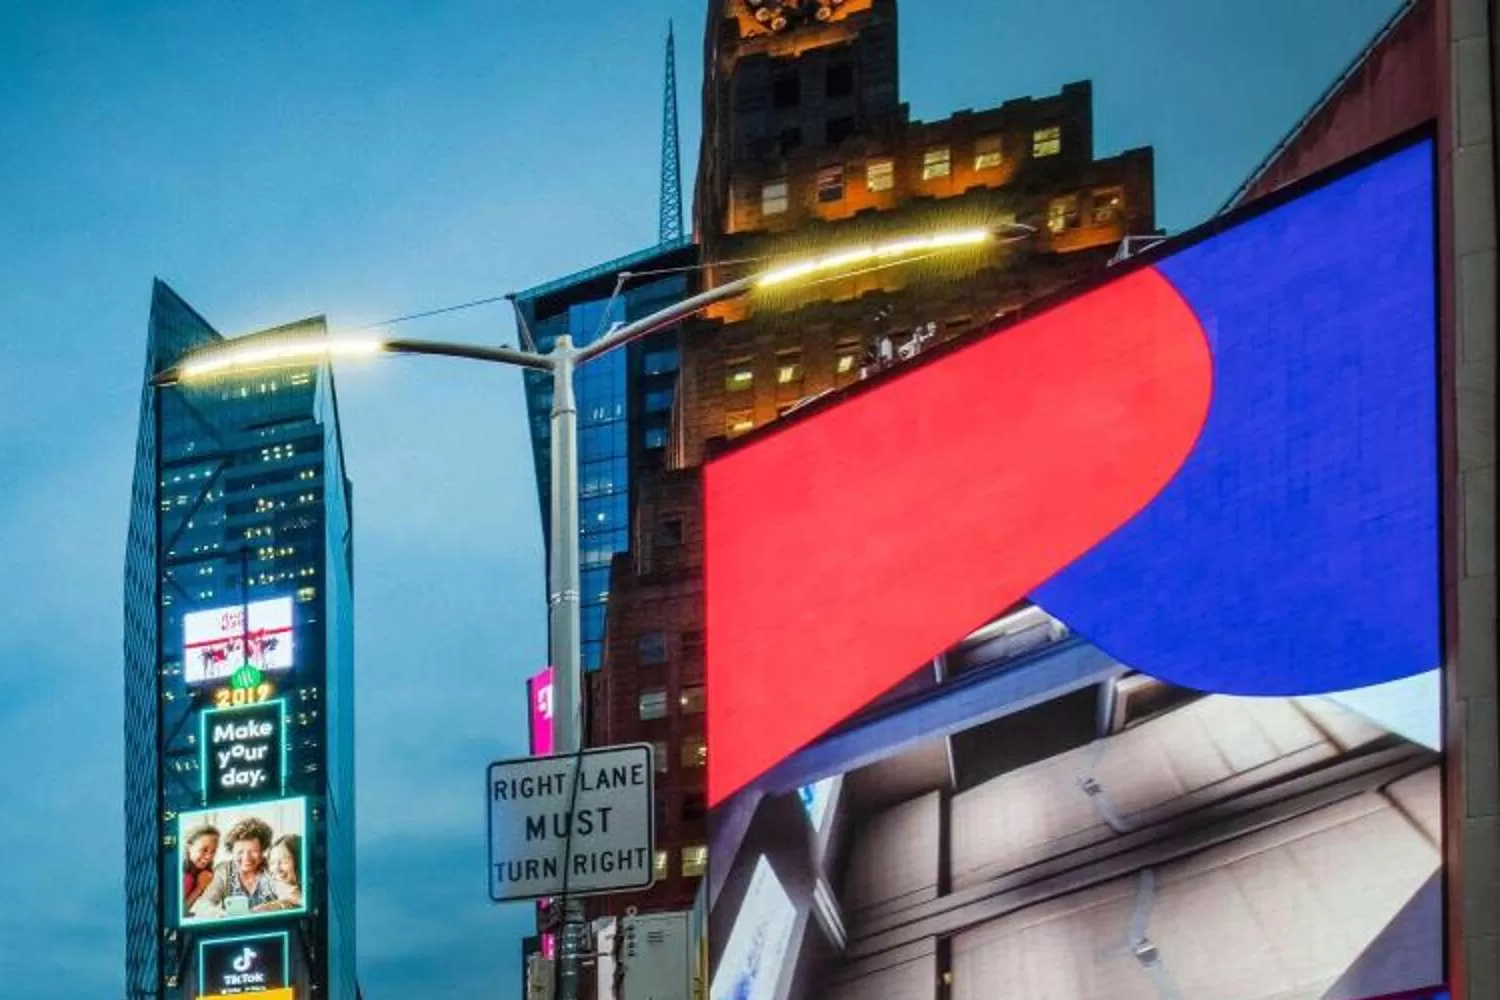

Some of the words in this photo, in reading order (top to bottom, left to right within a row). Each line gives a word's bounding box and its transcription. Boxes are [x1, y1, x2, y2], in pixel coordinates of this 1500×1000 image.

[213, 719, 273, 743] Make
[218, 744, 269, 769] your
[221, 768, 266, 788] day.
[493, 773, 567, 801] RIGHT
[580, 764, 645, 791] LANE
[525, 807, 613, 841] MUST
[492, 857, 557, 883] TURN
[573, 847, 647, 876] RIGHT
